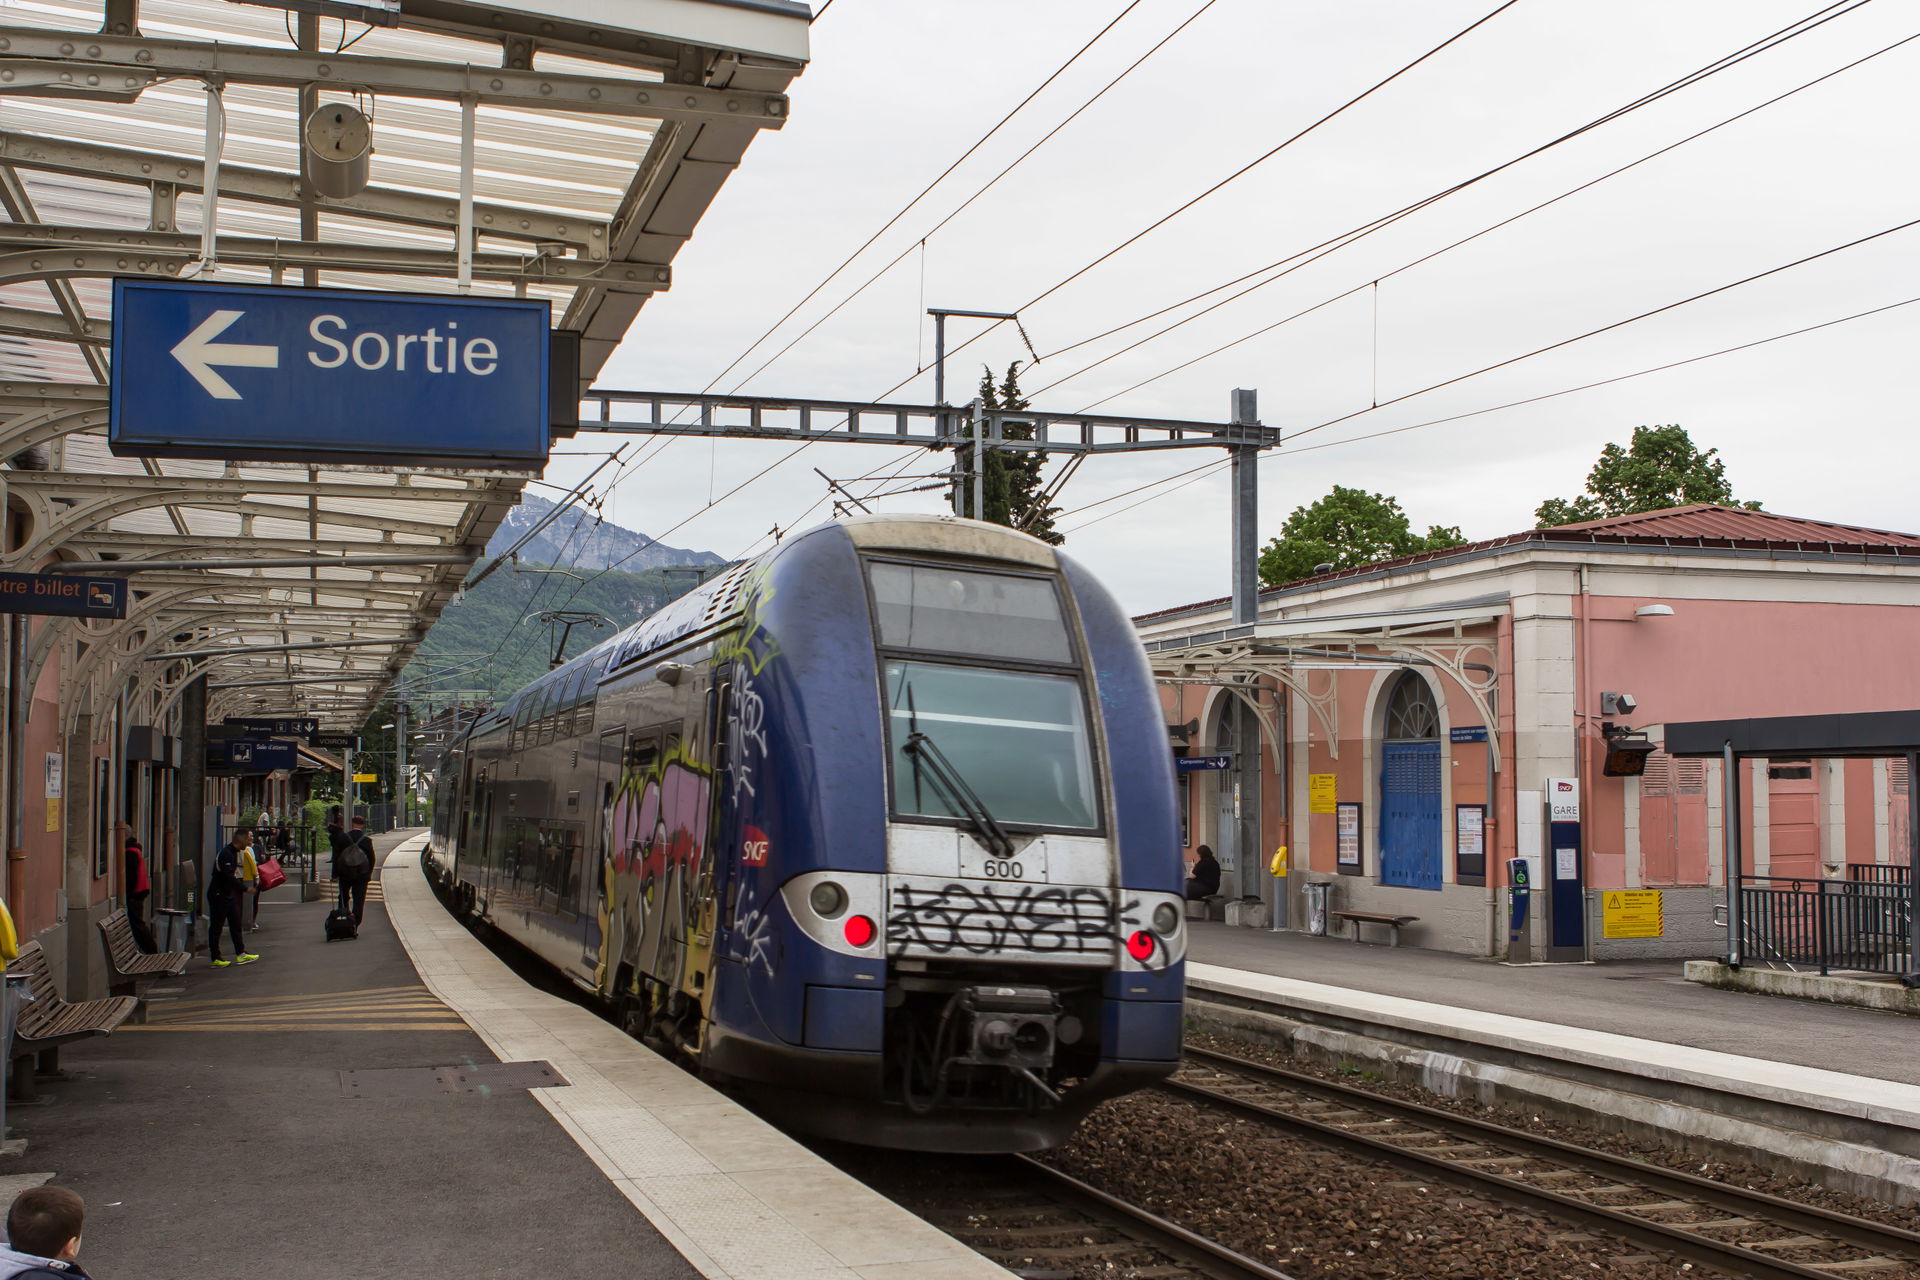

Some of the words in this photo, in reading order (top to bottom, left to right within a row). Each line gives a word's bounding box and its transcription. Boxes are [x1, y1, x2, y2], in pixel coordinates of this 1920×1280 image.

[307, 314, 499, 376] Sortie
[0, 580, 28, 594] tre
[34, 579, 81, 597] billet
[1553, 805, 1578, 815] GARE
[742, 841, 769, 861] SNCF
[984, 859, 1023, 879] 600
